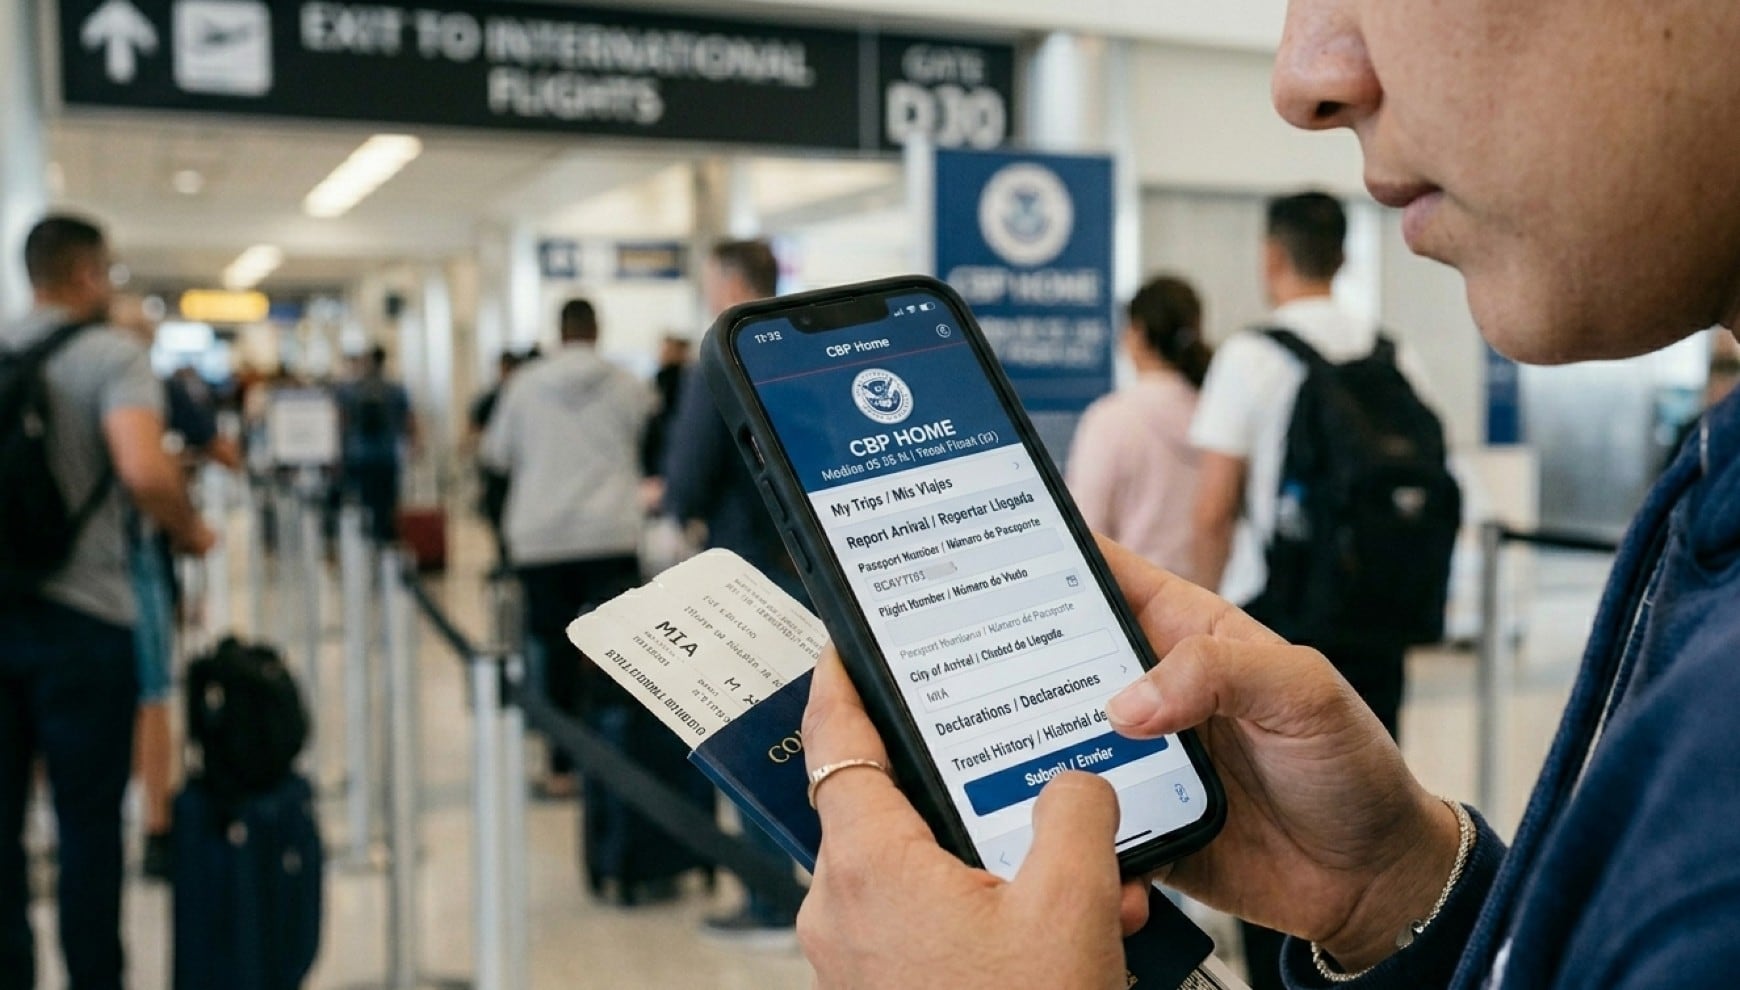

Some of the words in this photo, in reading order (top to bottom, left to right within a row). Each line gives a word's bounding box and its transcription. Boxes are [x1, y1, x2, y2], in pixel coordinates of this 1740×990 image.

[300, 2, 401, 55] EXIT
[416, 8, 482, 61] TO
[486, 17, 814, 87] INTERNATIONAL
[902, 44, 983, 85] GATE
[488, 67, 663, 123] FLIGHTS
[887, 81, 1006, 149] D30
[826, 344, 850, 358] CBP
[853, 338, 890, 352] Home
[850, 434, 890, 457] CBP
[893, 419, 956, 447] HOME
[831, 504, 850, 516] My
[851, 495, 883, 512] Trips
[893, 487, 915, 502] Mis
[656, 620, 698, 658] MIA
[931, 662, 942, 675] of
[935, 702, 1012, 736] Declarations
[1020, 674, 1100, 708] Declaraciones
[768, 730, 802, 764] CO
